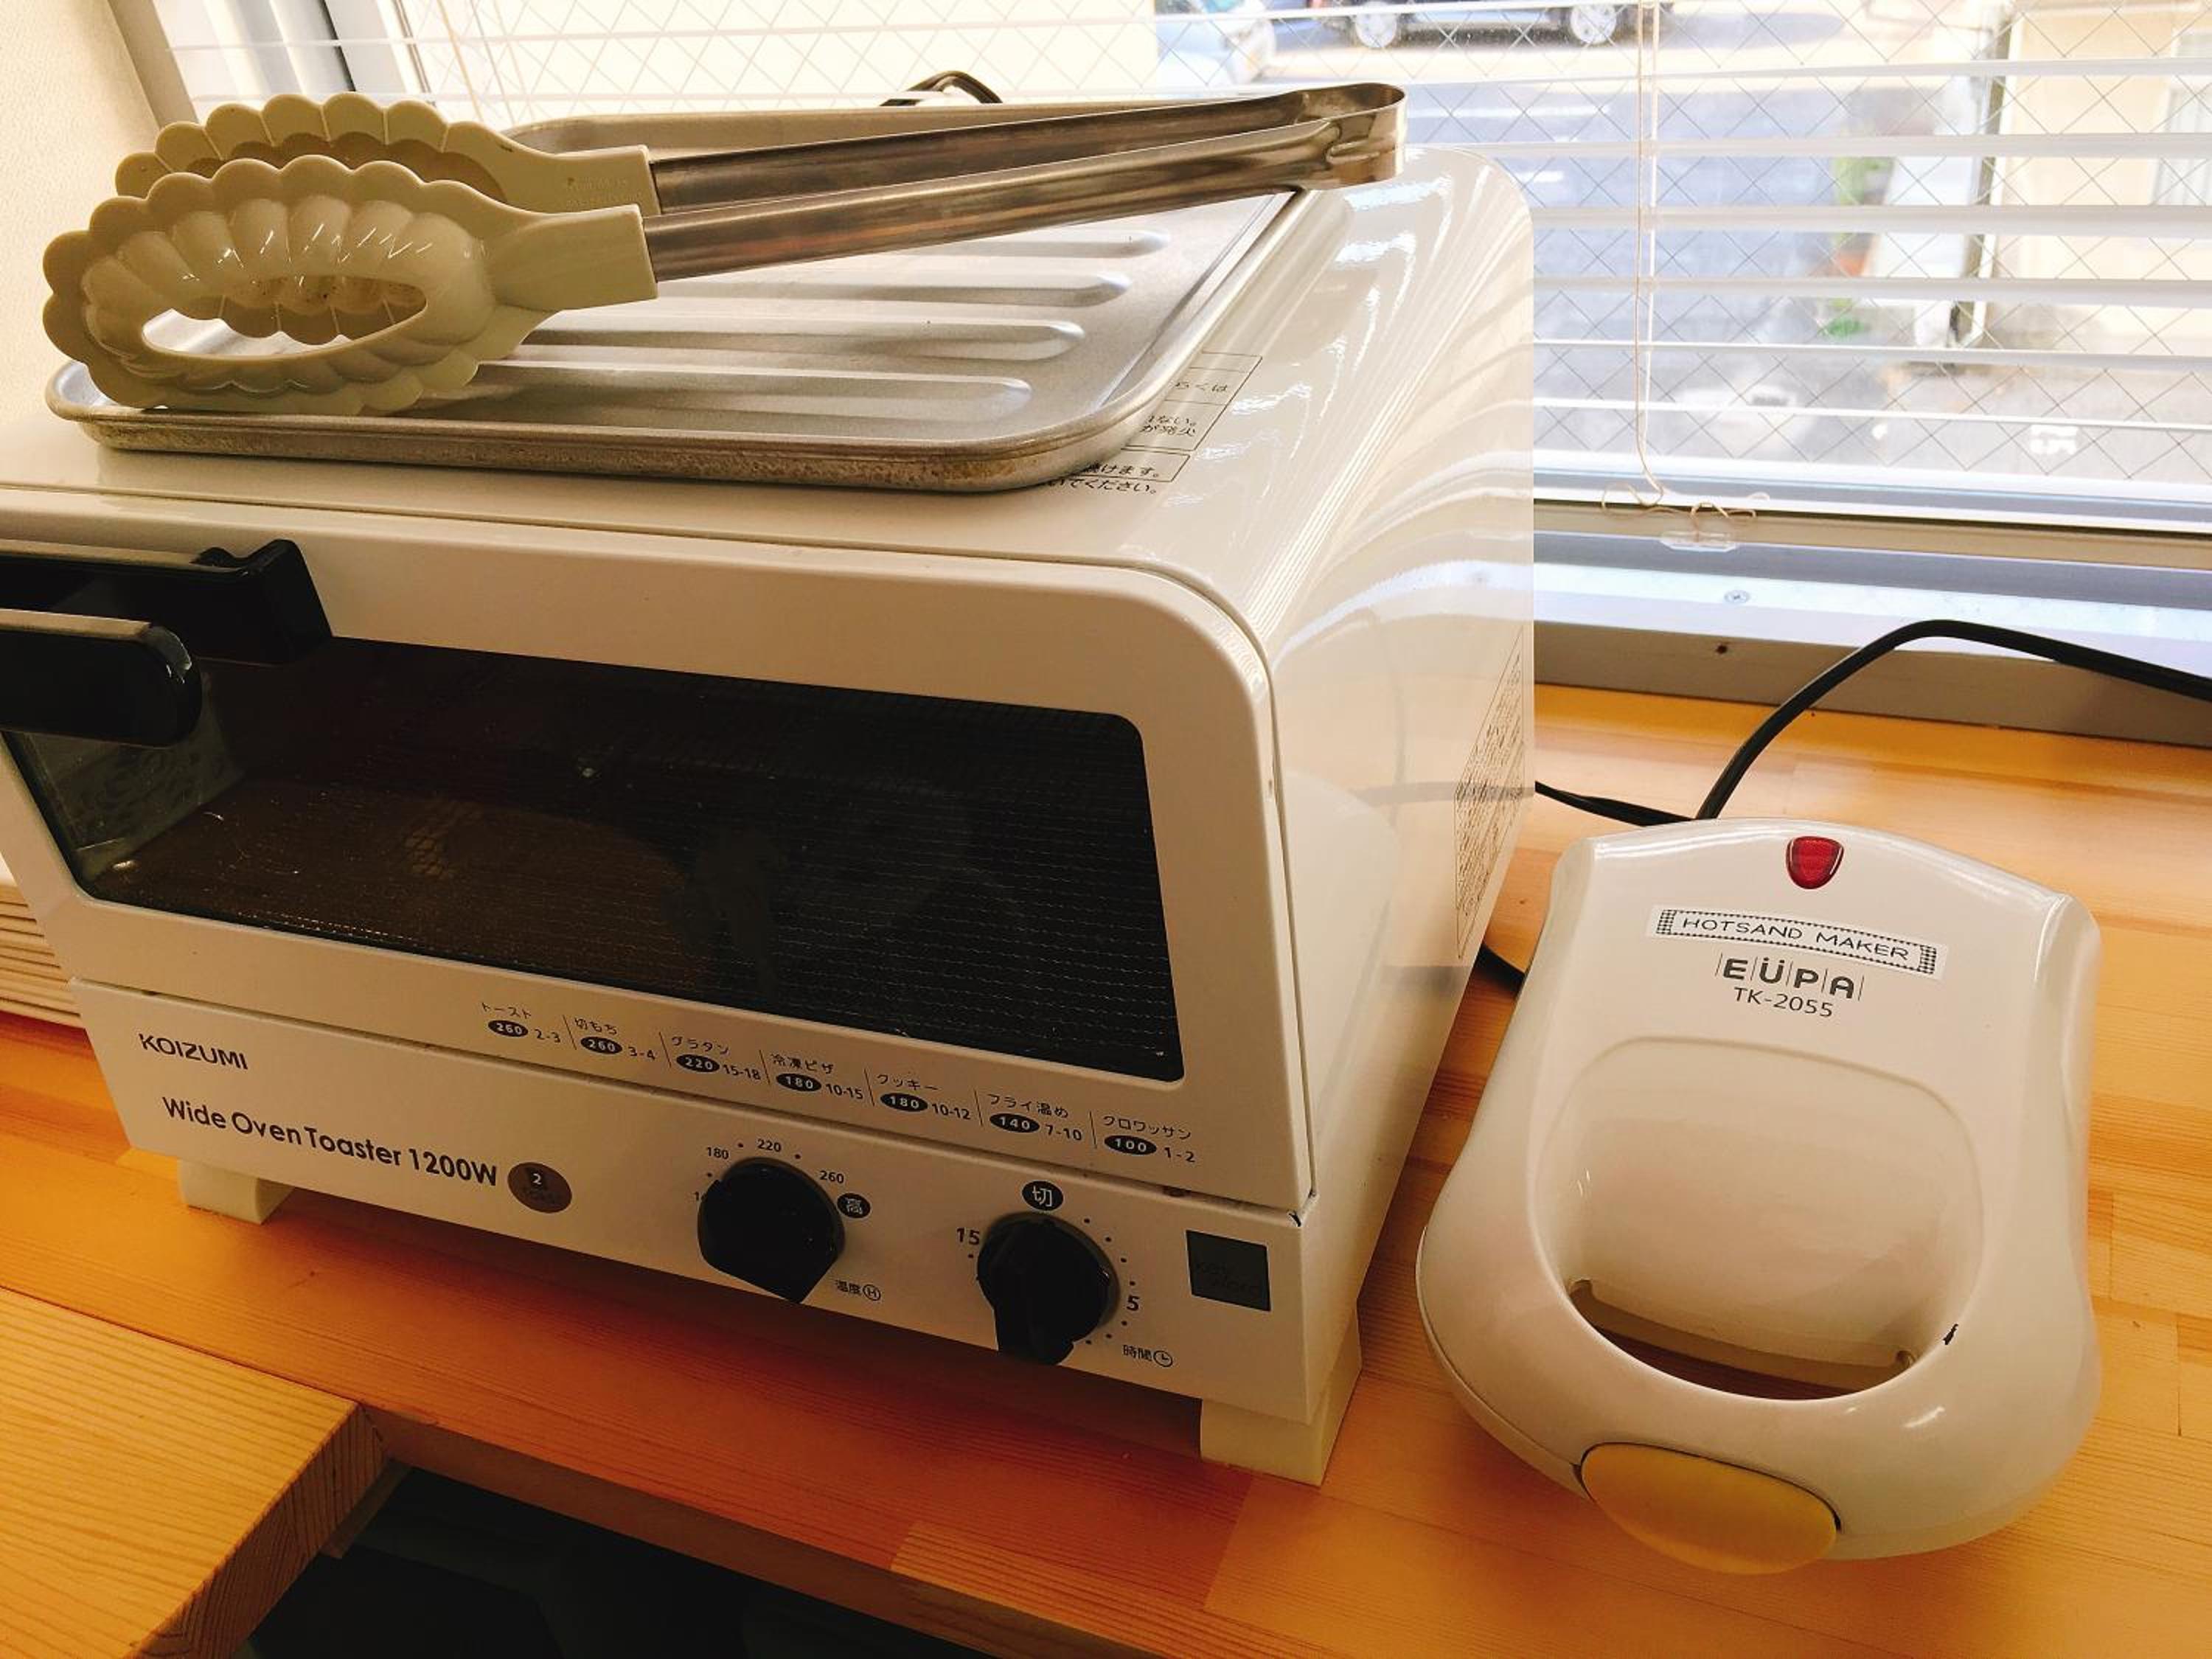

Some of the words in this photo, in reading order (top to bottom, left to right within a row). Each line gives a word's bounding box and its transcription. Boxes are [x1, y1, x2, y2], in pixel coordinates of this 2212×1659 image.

[1683, 918, 1803, 939] HOTSAND
[1816, 932, 1909, 960] MAKER
[481, 1002, 532, 1020] トースト
[1734, 987, 1834, 1018] TK-2055
[496, 1022, 523, 1034] 260
[535, 1029, 561, 1043] 2-3
[139, 1033, 248, 1070] KOIZUMI
[588, 1039, 616, 1052] 260
[628, 1046, 655, 1060] 3-4
[672, 1036, 730, 1055] グラタン
[685, 1057, 713, 1069] 220
[723, 1064, 762, 1081] 15-18
[771, 1052, 834, 1074] 冷凍ピザ
[785, 1076, 814, 1089] 180
[826, 1083, 863, 1099] 10-15
[877, 1074, 940, 1091] クッキー
[889, 1096, 919, 1109] 180
[932, 1103, 971, 1119] 10-12
[988, 1093, 1068, 1119] フライ温め
[998, 1116, 1030, 1130] 140
[1045, 1124, 1082, 1141] 7-10
[1103, 1116, 1192, 1140] クロワッサン
[161, 1097, 227, 1129] Wide
[232, 1112, 302, 1144] Oven
[303, 1127, 402, 1166] Toaster
[408, 1148, 497, 1186] 1200W
[757, 1138, 782, 1152] 220
[1114, 1138, 1147, 1152] 100
[1164, 1147, 1196, 1163] 1-2
[707, 1147, 729, 1160] 180
[532, 1172, 543, 1185] 2
[820, 1170, 844, 1184] 260
[1032, 1186, 1053, 1207] 切
[956, 1228, 981, 1245] 15
[1126, 1295, 1140, 1311] 5
